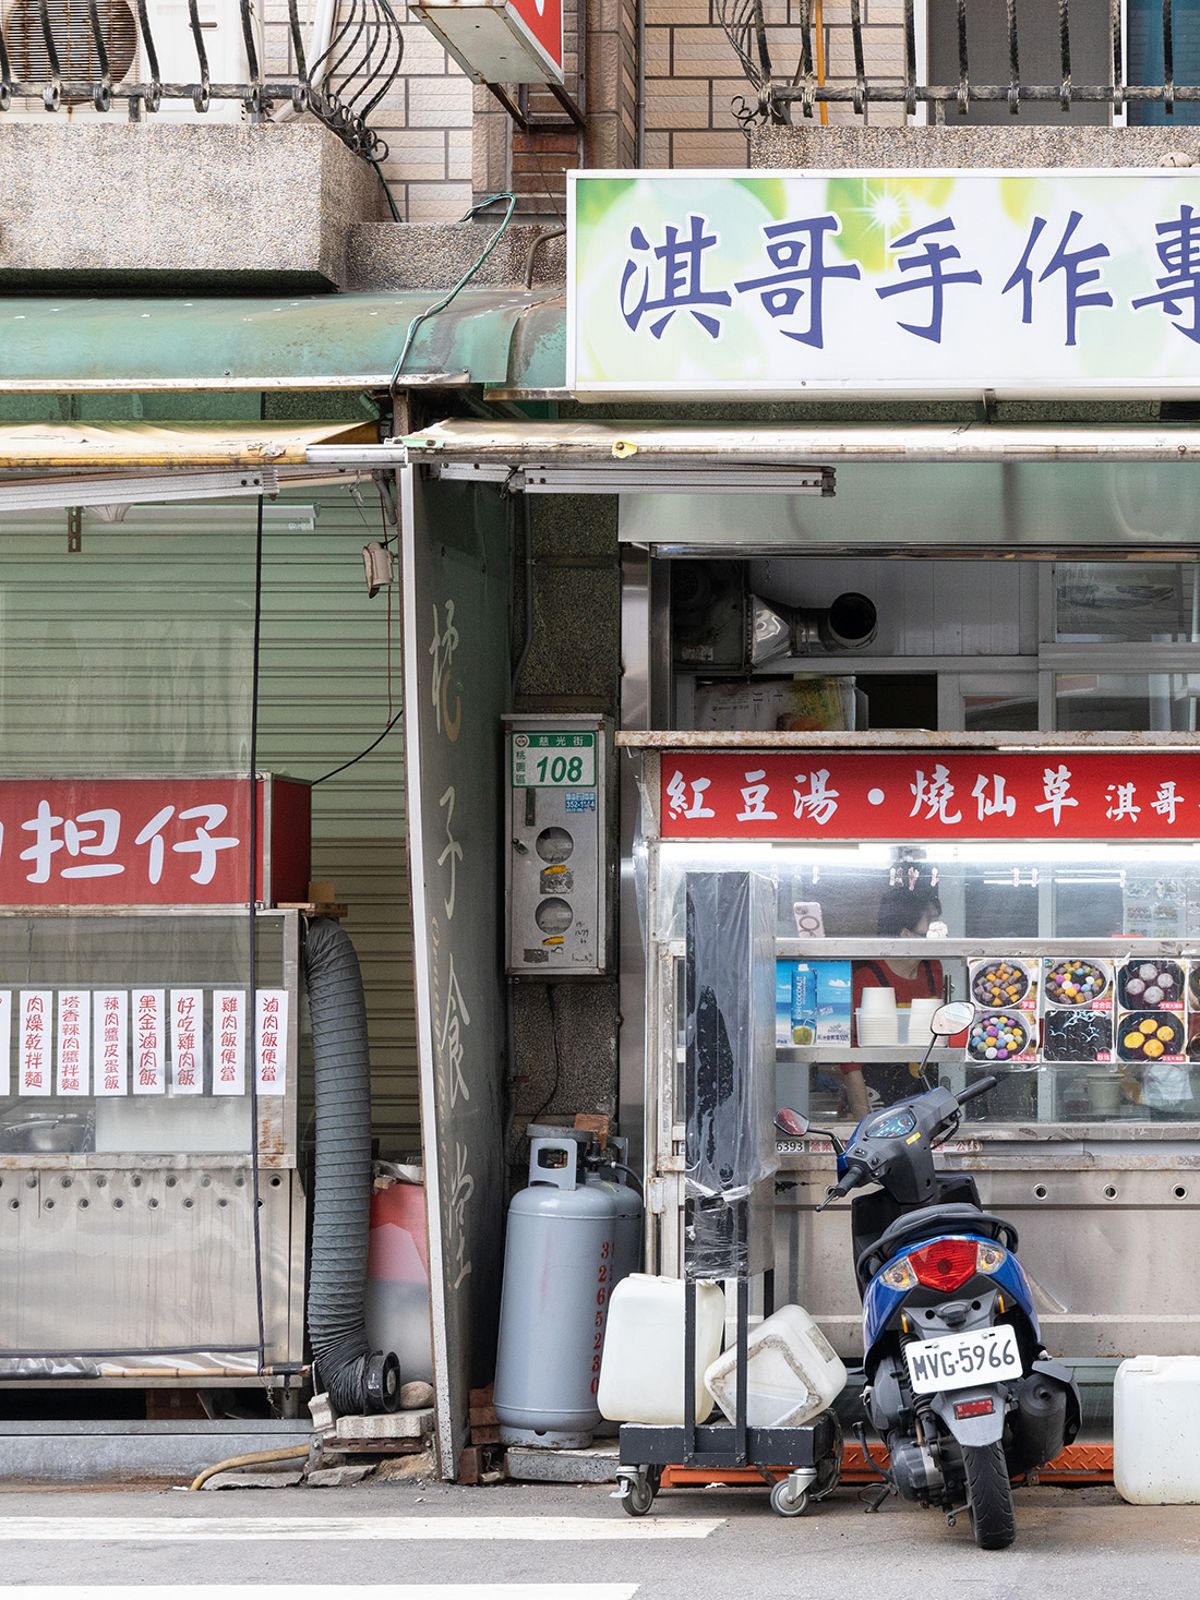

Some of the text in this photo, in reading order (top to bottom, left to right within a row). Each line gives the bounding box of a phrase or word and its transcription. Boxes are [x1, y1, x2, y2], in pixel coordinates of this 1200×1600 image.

[516, 751, 526, 784] 桃園區
[537, 756, 583, 782] 108
[539, 735, 583, 746] 慈光街
[0, 800, 240, 884] 担仔
[139, 995, 157, 1085] 黑金滷肉飯
[177, 997, 195, 1085] 好吃雞肉飯
[221, 997, 237, 1081] 雞肉飯便當
[261, 997, 278, 1081] 滷肉飯便當
